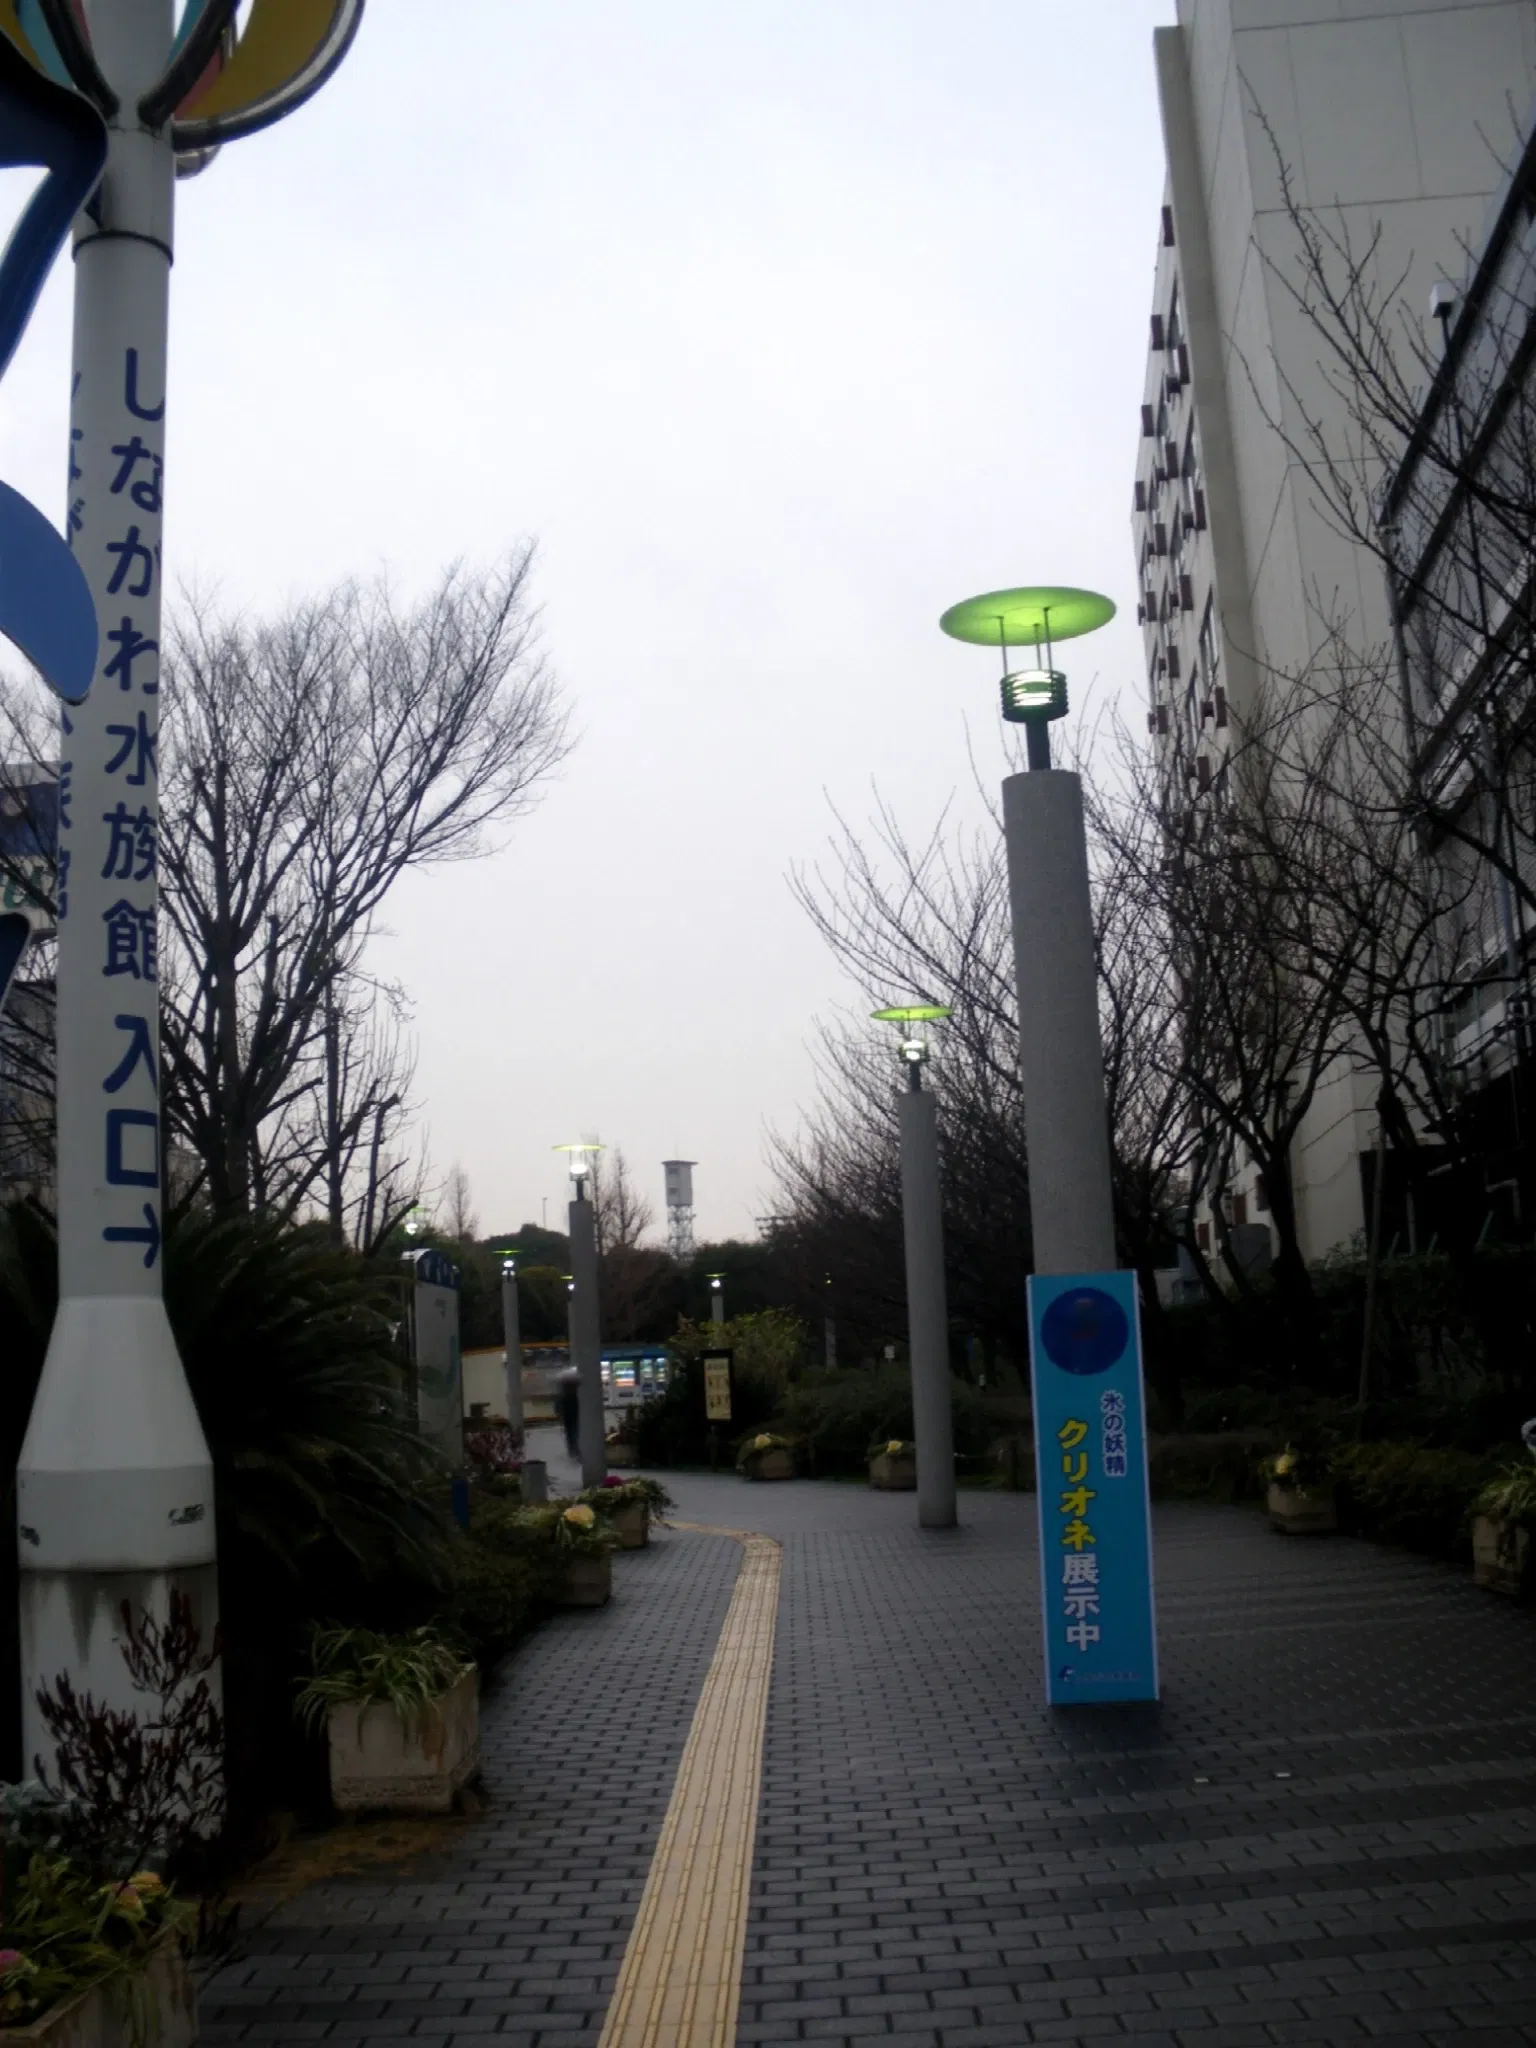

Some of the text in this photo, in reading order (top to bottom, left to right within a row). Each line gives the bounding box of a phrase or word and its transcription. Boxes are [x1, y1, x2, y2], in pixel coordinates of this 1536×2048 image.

[1100, 1390, 1126, 1476] 氷の妖精
[1058, 1419, 1100, 1652] クリオネ展示中
